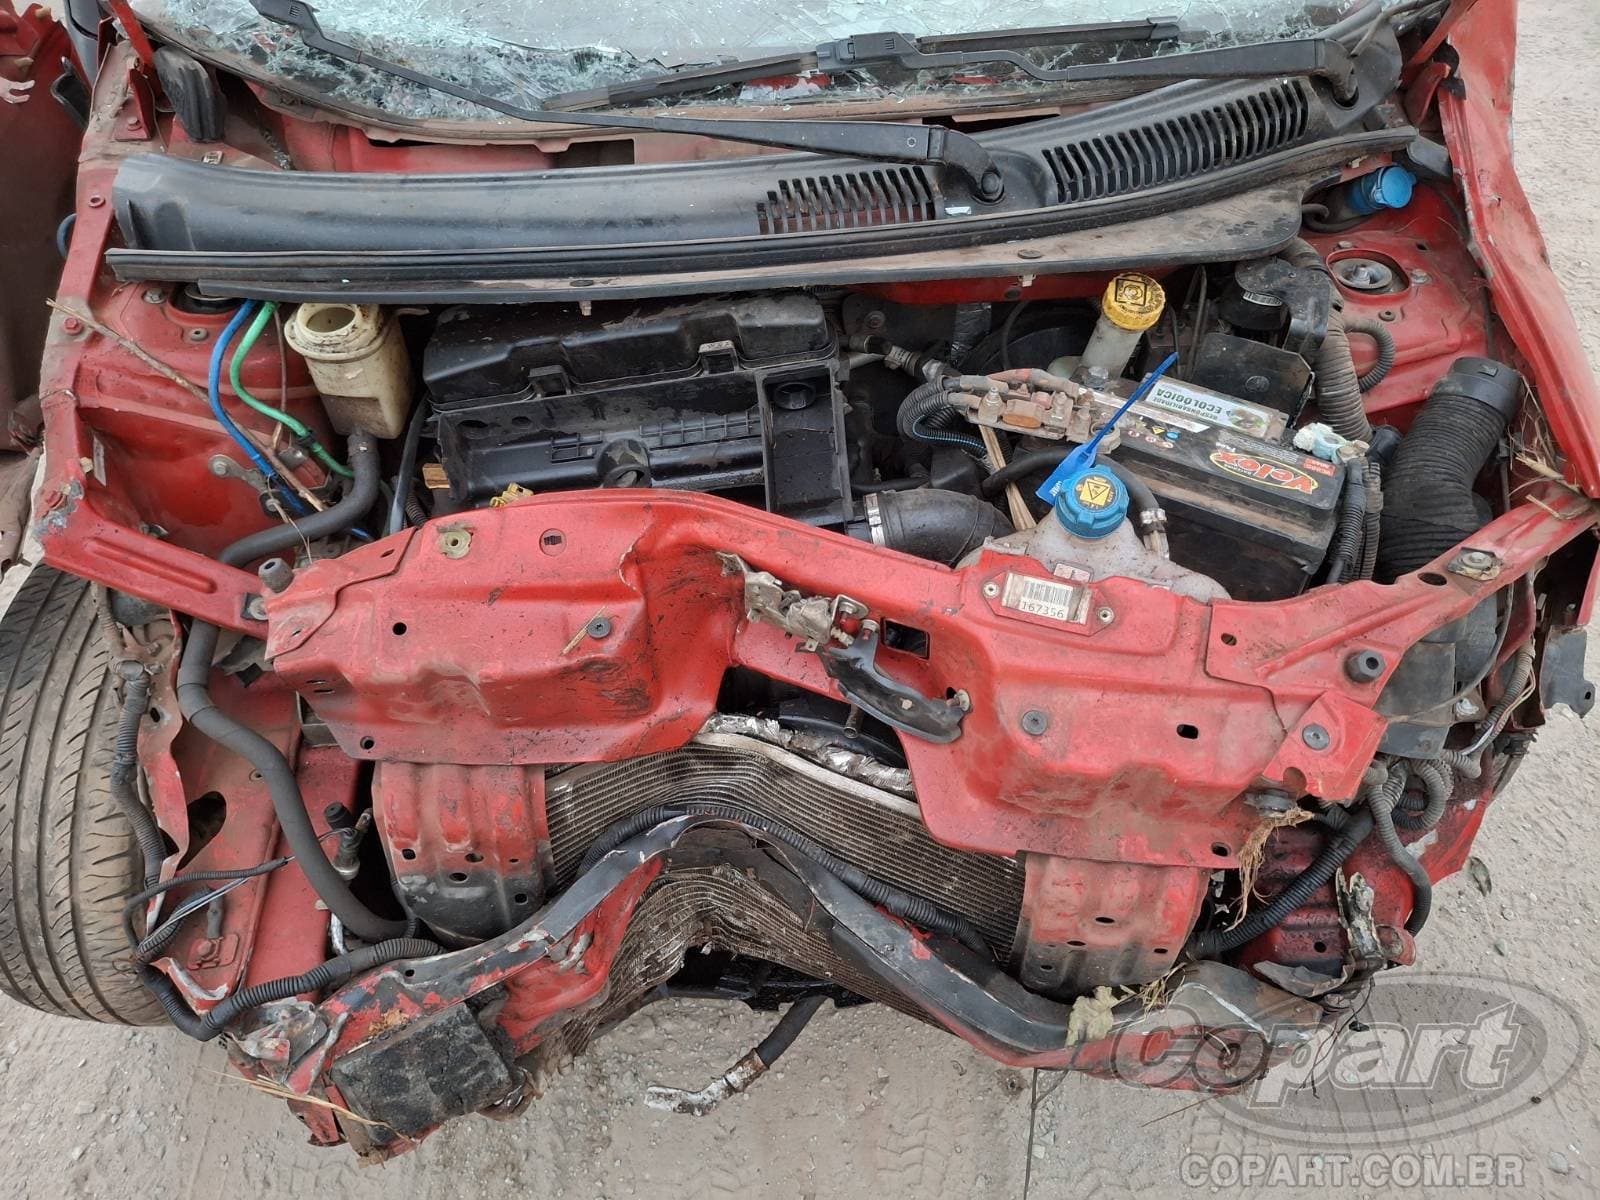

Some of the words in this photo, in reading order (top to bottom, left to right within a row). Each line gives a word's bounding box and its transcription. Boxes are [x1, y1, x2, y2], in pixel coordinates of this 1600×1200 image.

[1153, 396, 1218, 420] RESPONSABILIDADE
[1213, 452, 1313, 495] Velox
[1021, 601, 1065, 618] 167356
